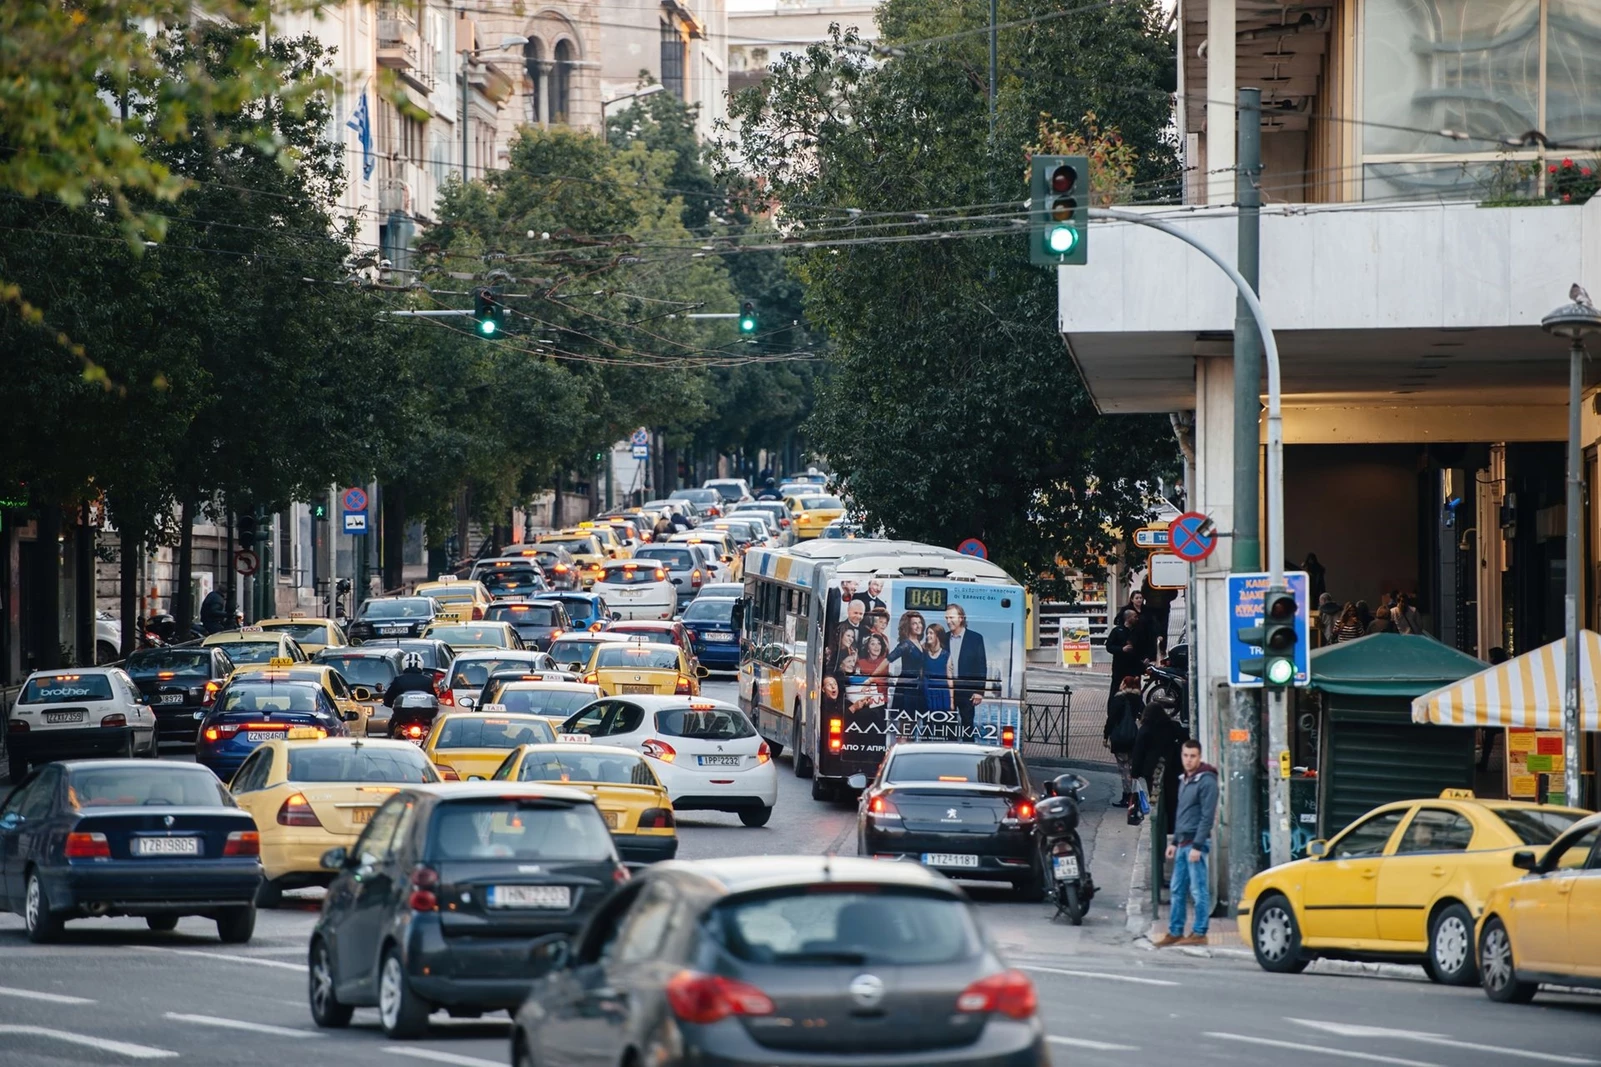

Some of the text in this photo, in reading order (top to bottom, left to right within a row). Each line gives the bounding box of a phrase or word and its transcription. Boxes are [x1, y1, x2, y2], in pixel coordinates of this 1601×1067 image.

[911, 588, 942, 607] 040
[40, 688, 90, 696] brother
[884, 708, 959, 724] ΓΑΜΟΣ
[982, 725, 998, 740] 2
